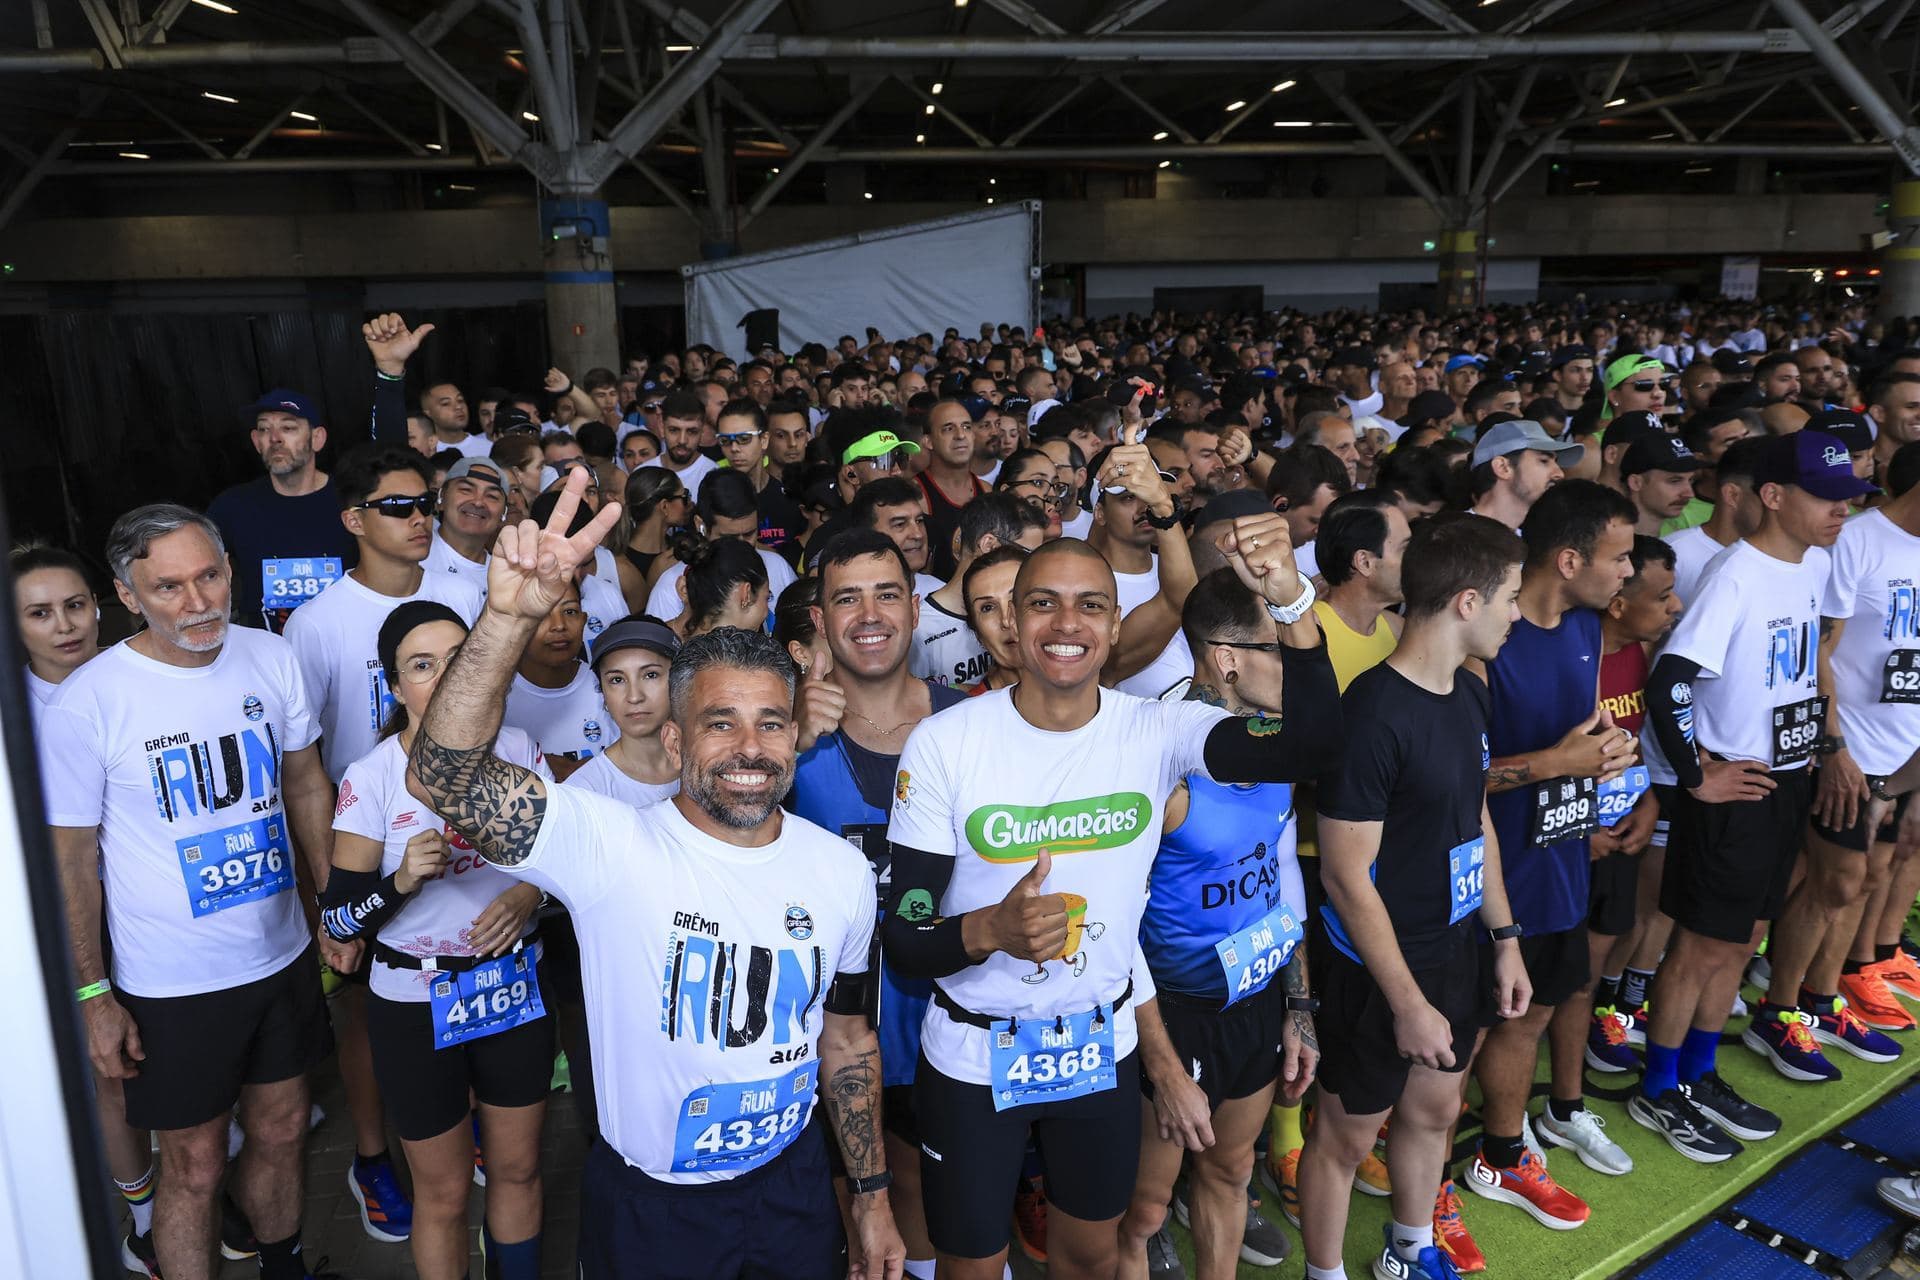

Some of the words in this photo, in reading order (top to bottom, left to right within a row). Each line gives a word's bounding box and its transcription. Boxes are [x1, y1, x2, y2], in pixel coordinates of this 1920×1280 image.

[273, 577, 335, 596] 3387
[1890, 671, 1920, 690] 62
[145, 731, 190, 752] GRÊMIO
[154, 722, 280, 823] RUN
[1542, 798, 1589, 831] 5989
[200, 848, 282, 892] 3976
[355, 893, 384, 920] alfa
[446, 980, 527, 1025] 4169
[667, 936, 822, 1052] RUN
[769, 1042, 809, 1064] alfa
[1006, 1042, 1101, 1085] 4368
[694, 1102, 801, 1153] 4338
